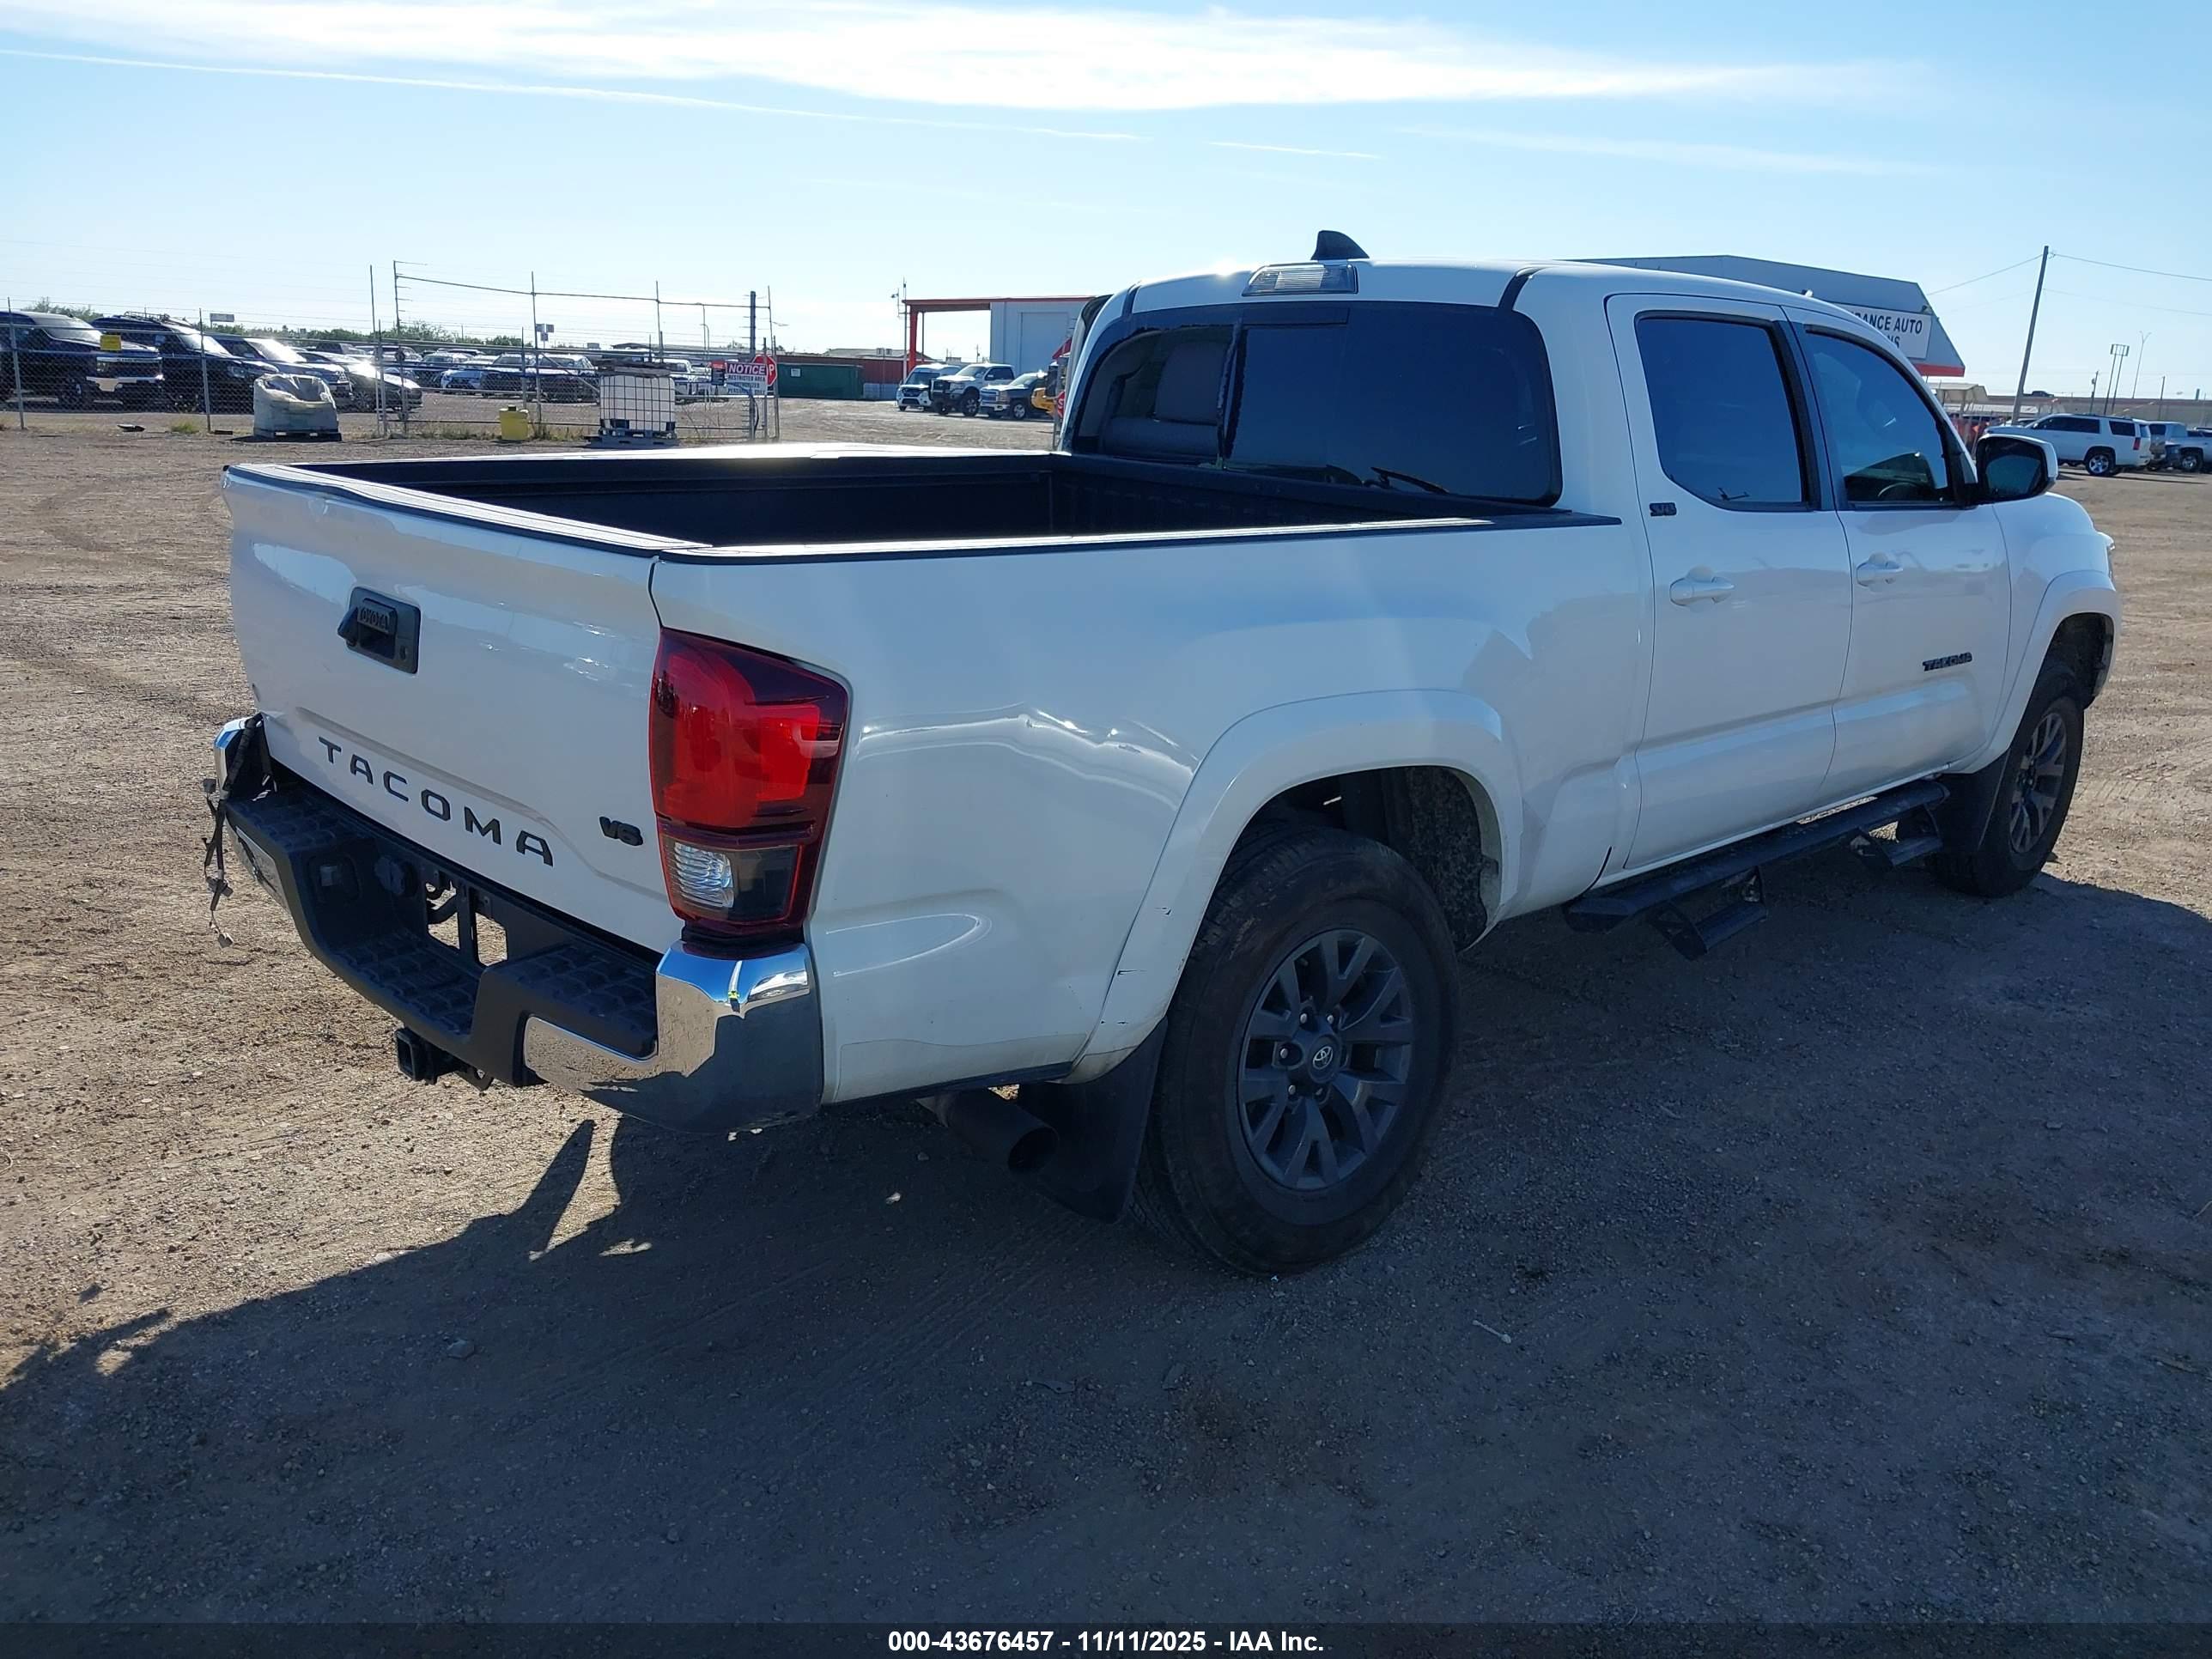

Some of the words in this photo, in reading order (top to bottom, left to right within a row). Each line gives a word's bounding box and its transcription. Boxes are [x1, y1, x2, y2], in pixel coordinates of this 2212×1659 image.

[1851, 311, 1892, 331] RANCE
[1893, 317, 1923, 334] AUTO
[728, 363, 766, 375] NOTICE
[1922, 652, 1973, 672] TACOMA
[319, 737, 554, 867] TACOMA
[599, 816, 643, 847] V6
